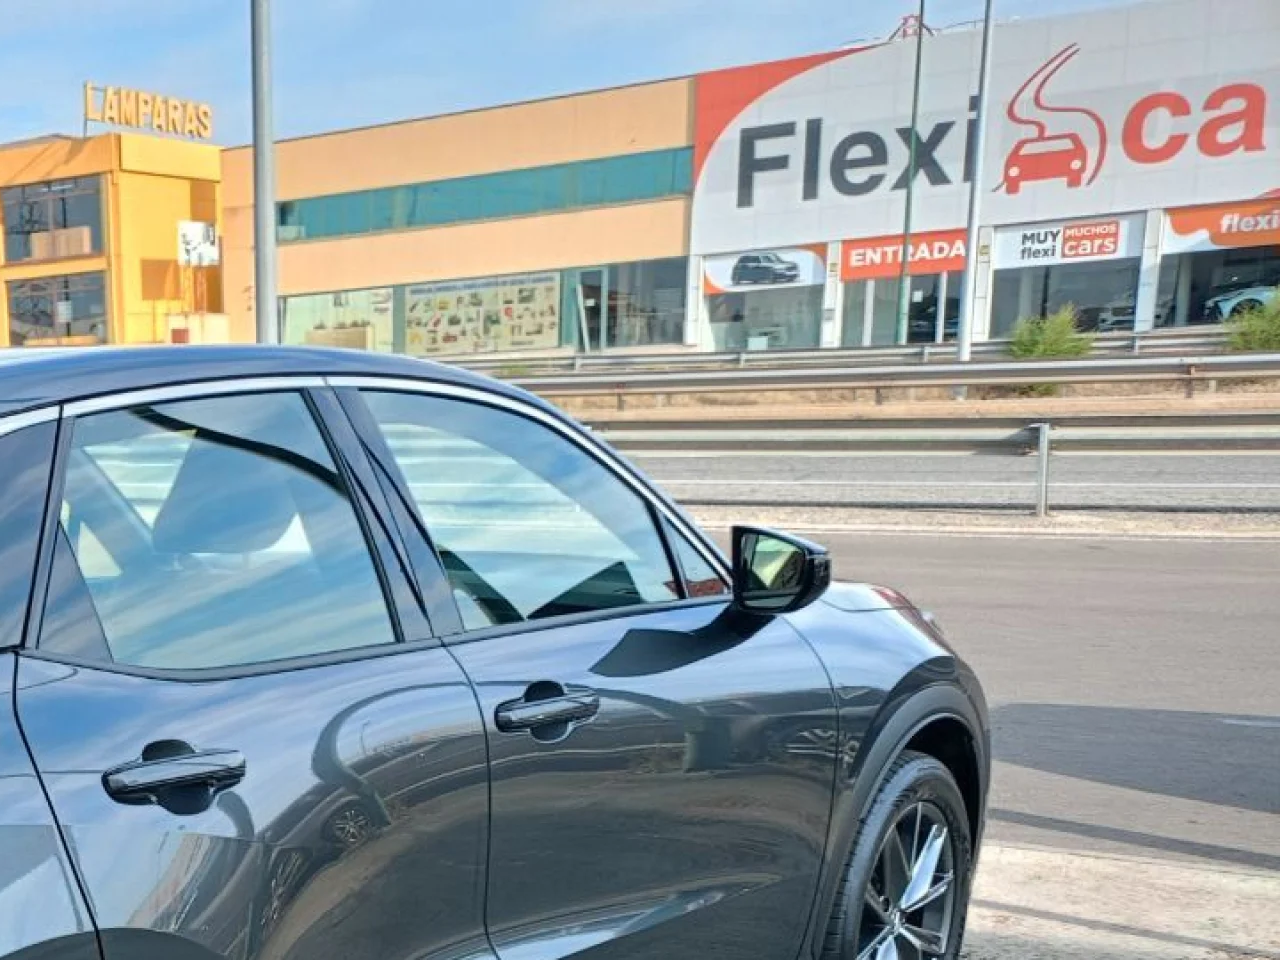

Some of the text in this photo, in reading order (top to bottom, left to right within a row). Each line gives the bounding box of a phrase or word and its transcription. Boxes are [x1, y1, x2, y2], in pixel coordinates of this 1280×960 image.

[85, 80, 212, 138] LAMPARAS
[736, 95, 981, 208] Flexi
[1021, 224, 1117, 245] MUY MUCHOS
[849, 240, 966, 267] ENTRADA
[1021, 238, 1115, 259] flexi cars
